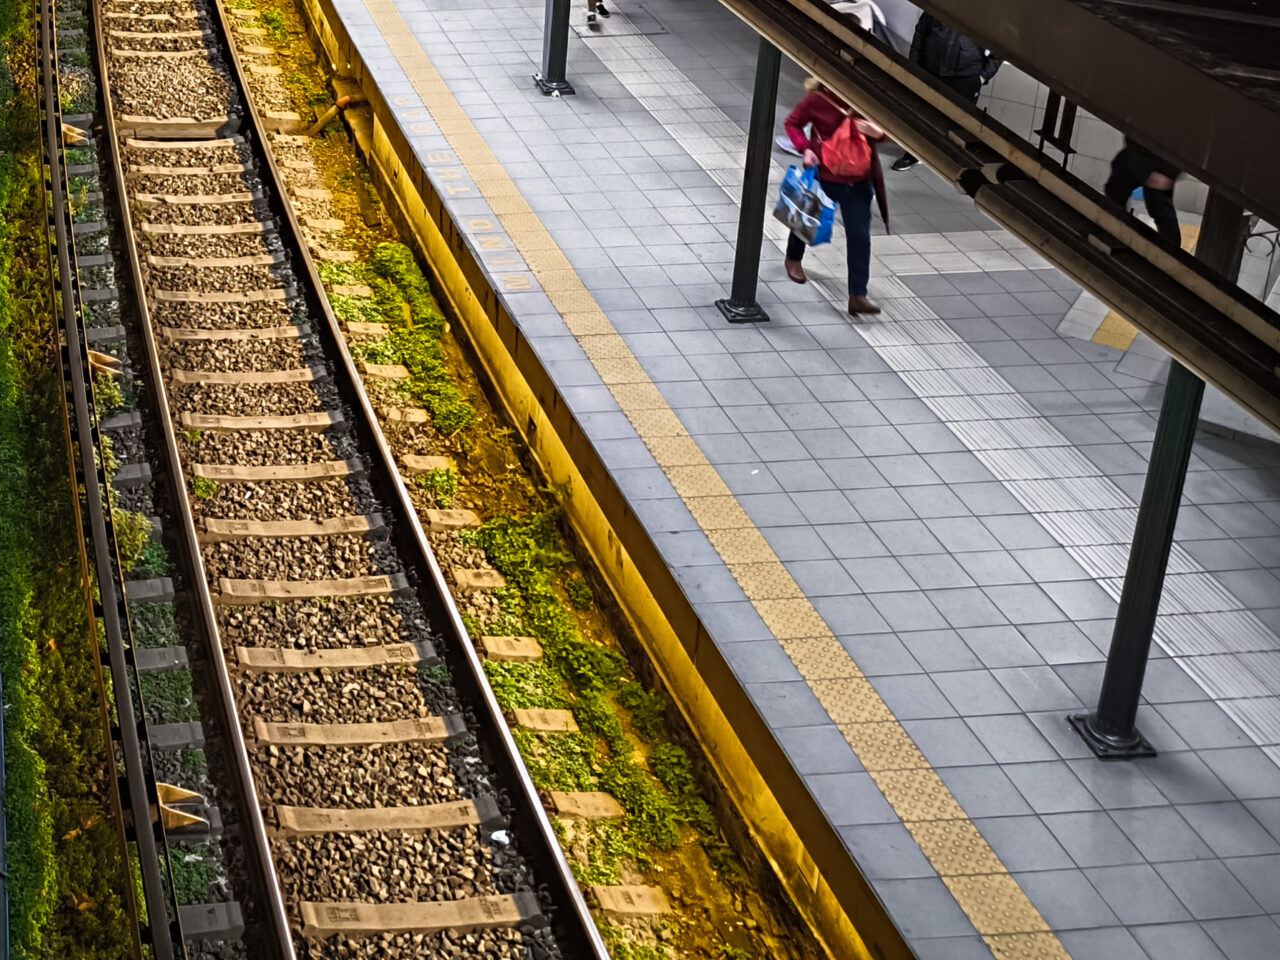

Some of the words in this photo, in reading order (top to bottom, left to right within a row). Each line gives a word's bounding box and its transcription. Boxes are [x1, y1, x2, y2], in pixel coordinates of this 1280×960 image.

[393, 96, 434, 136] GAP
[425, 151, 473, 197] THE
[467, 218, 533, 291] MIND
